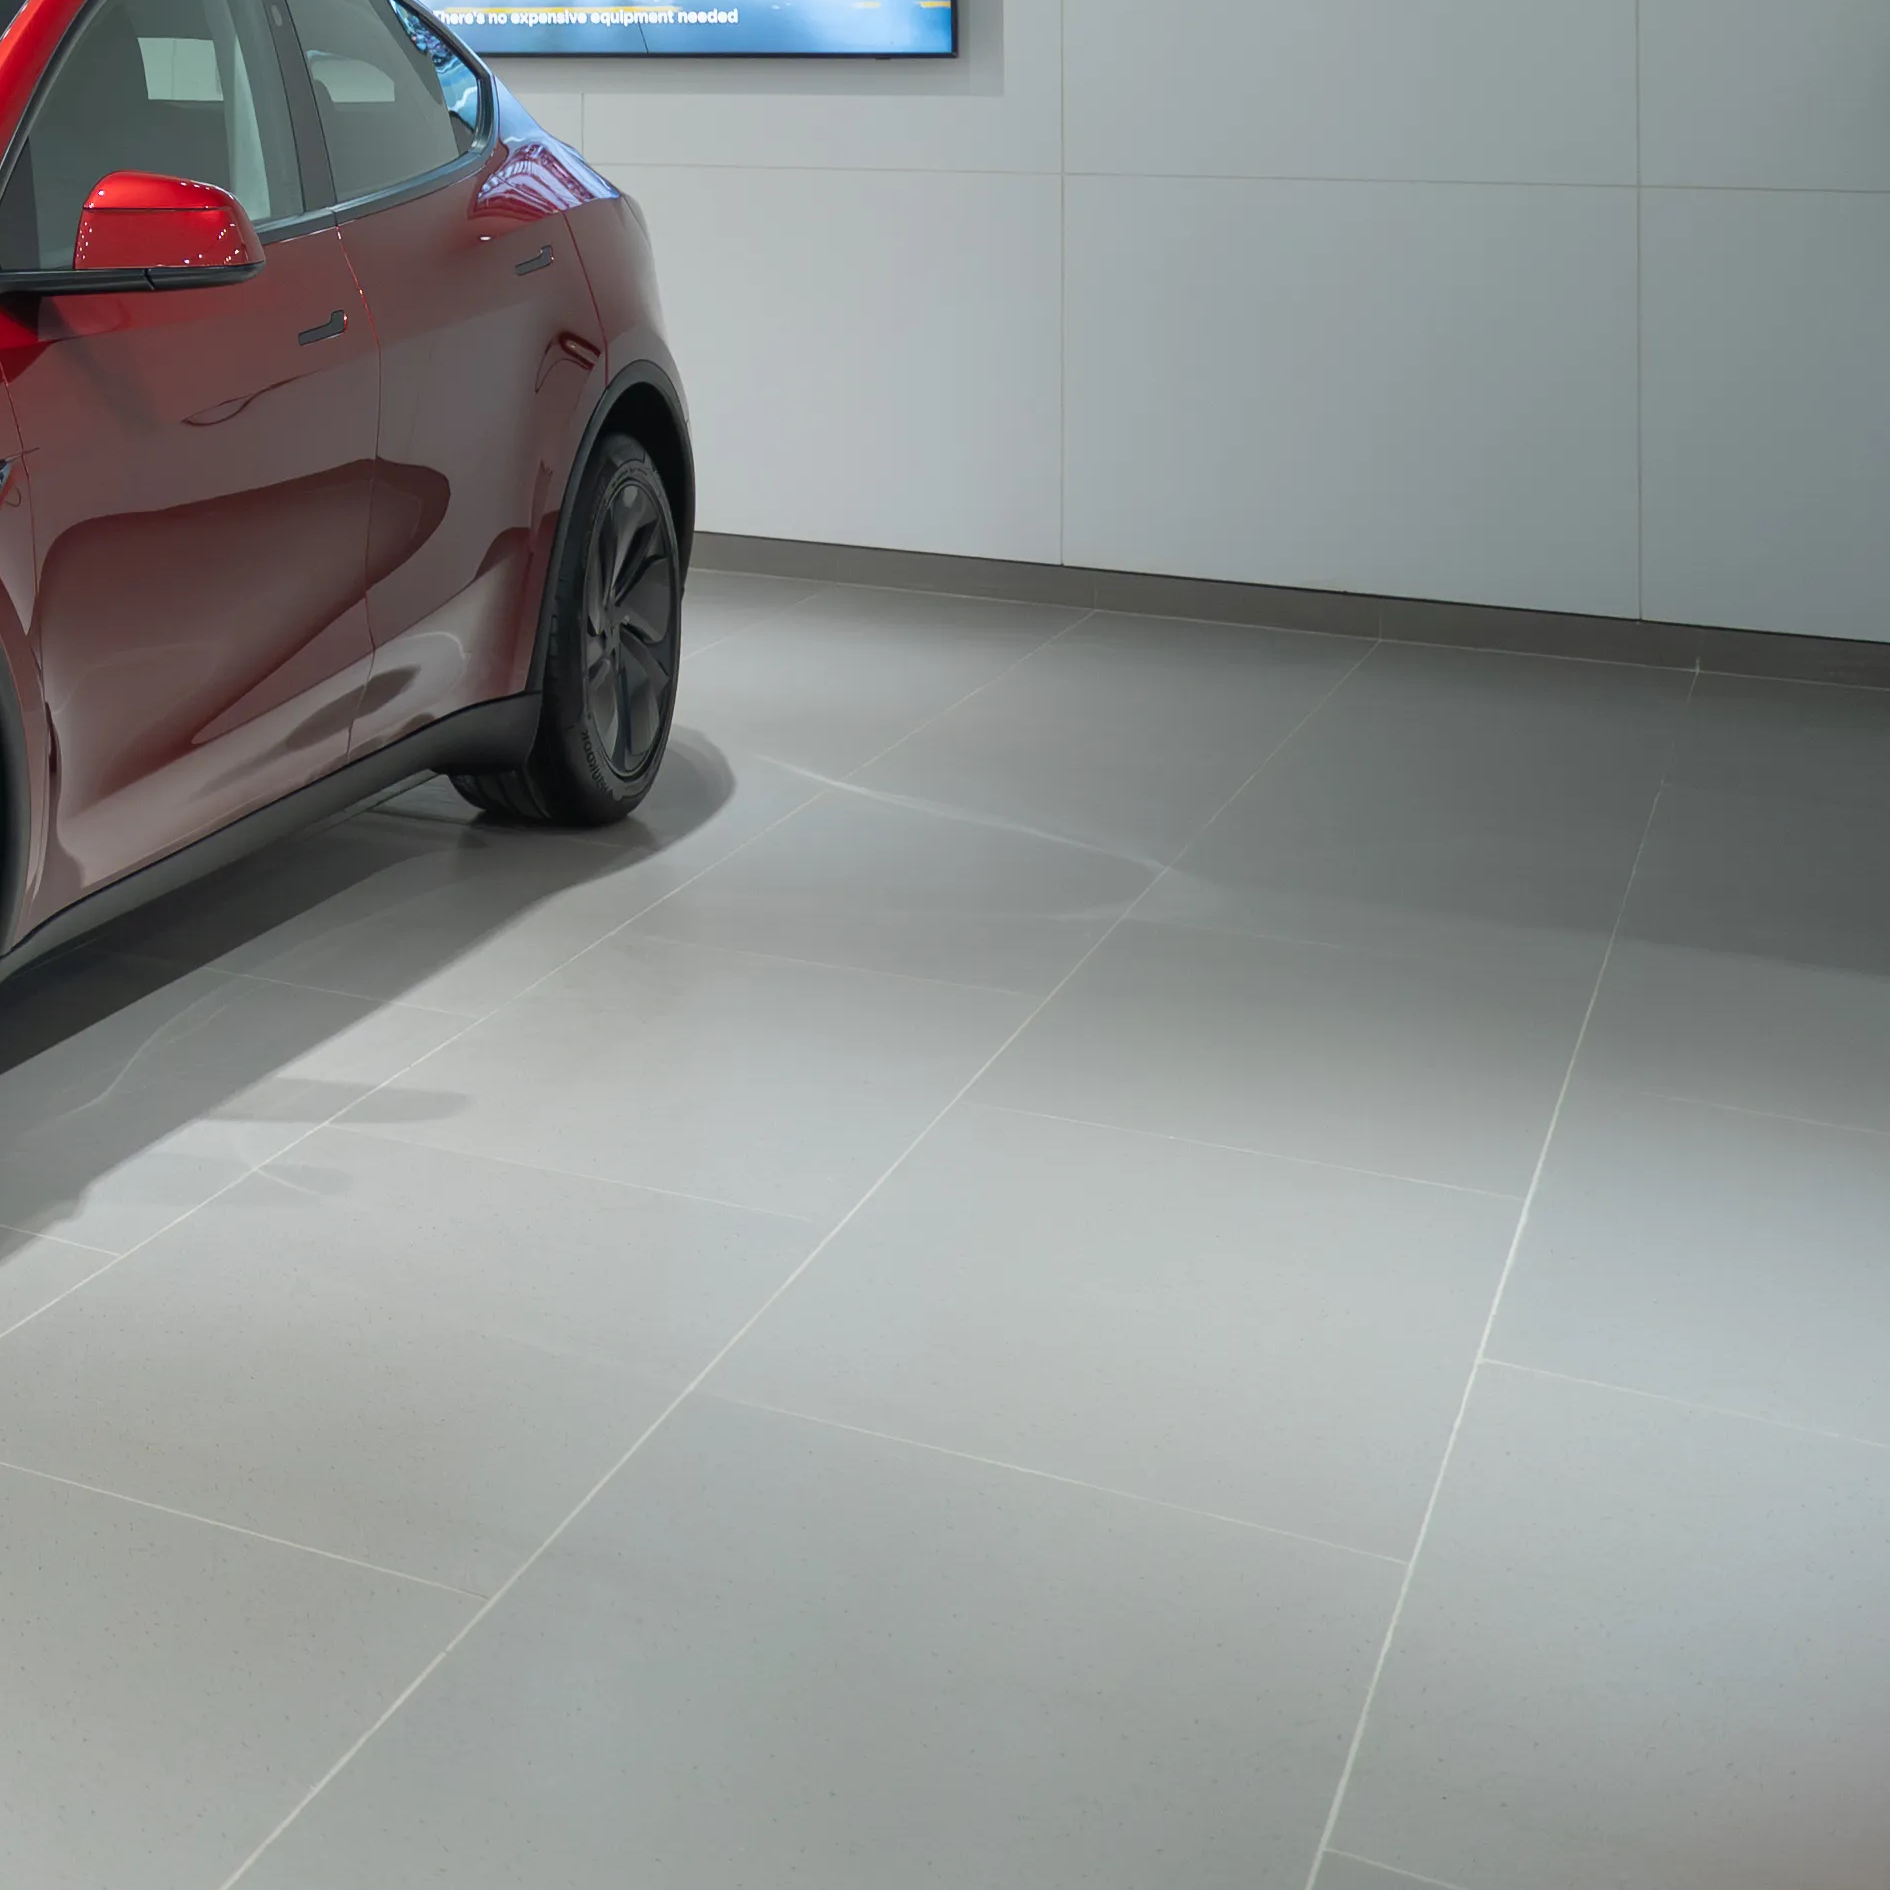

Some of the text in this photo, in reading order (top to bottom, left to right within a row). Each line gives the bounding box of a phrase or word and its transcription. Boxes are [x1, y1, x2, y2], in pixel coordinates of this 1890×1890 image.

[489, 12, 508, 25] no
[511, 9, 588, 28] expensive
[590, 9, 674, 27] equipment
[678, 8, 739, 24] needed
